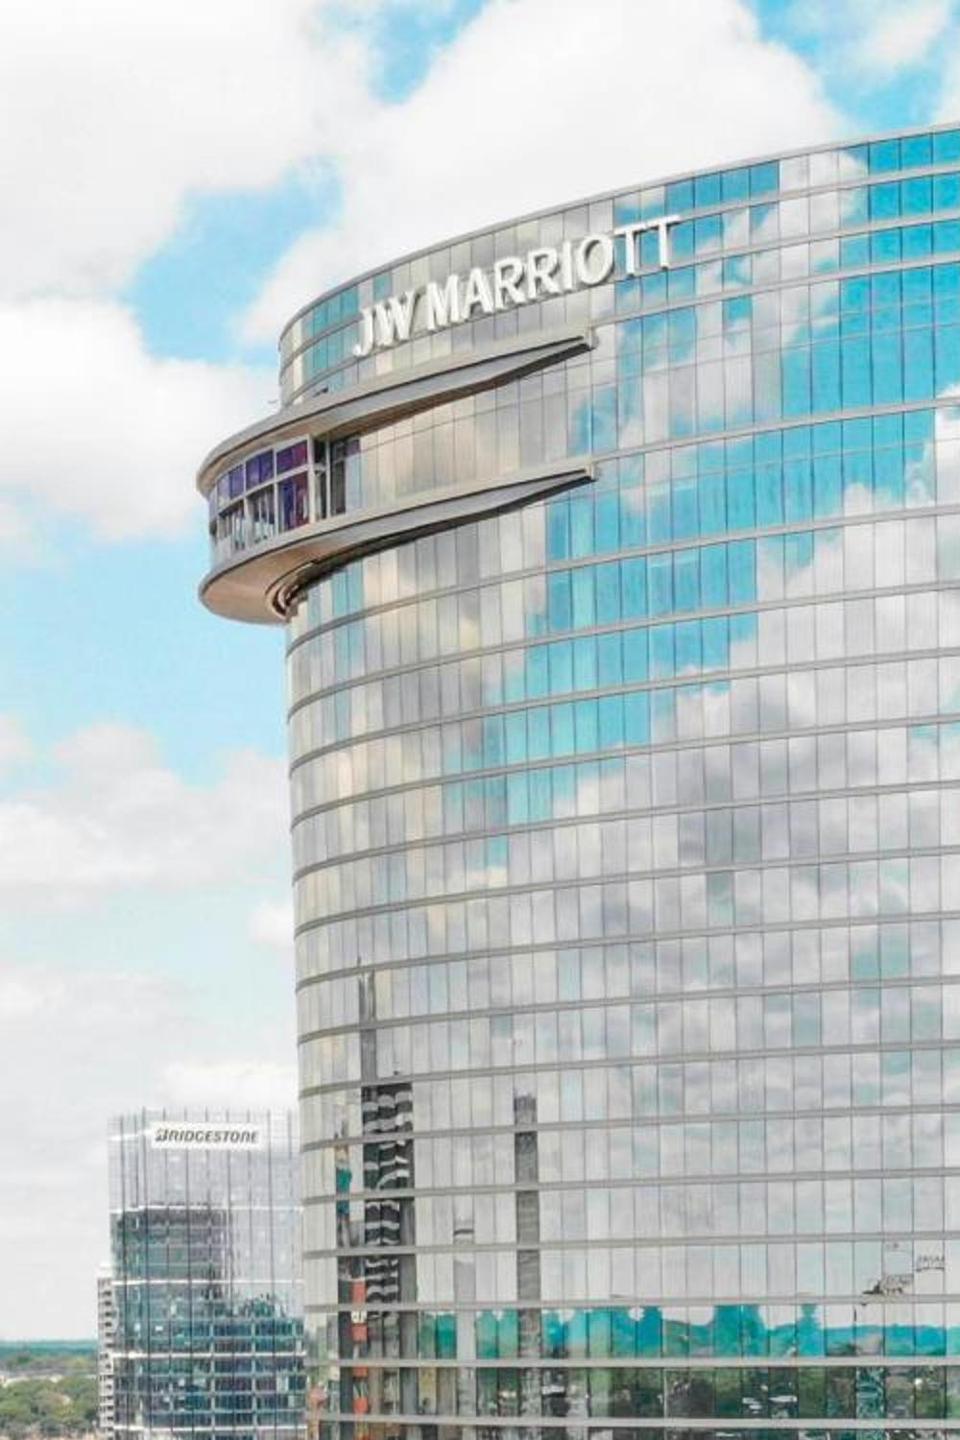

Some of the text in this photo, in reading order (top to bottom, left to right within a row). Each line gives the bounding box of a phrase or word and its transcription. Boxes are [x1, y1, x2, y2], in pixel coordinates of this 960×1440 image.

[353, 215, 681, 356] JW MARRIOTT
[155, 1129, 259, 1142] BRIDGESTONE
